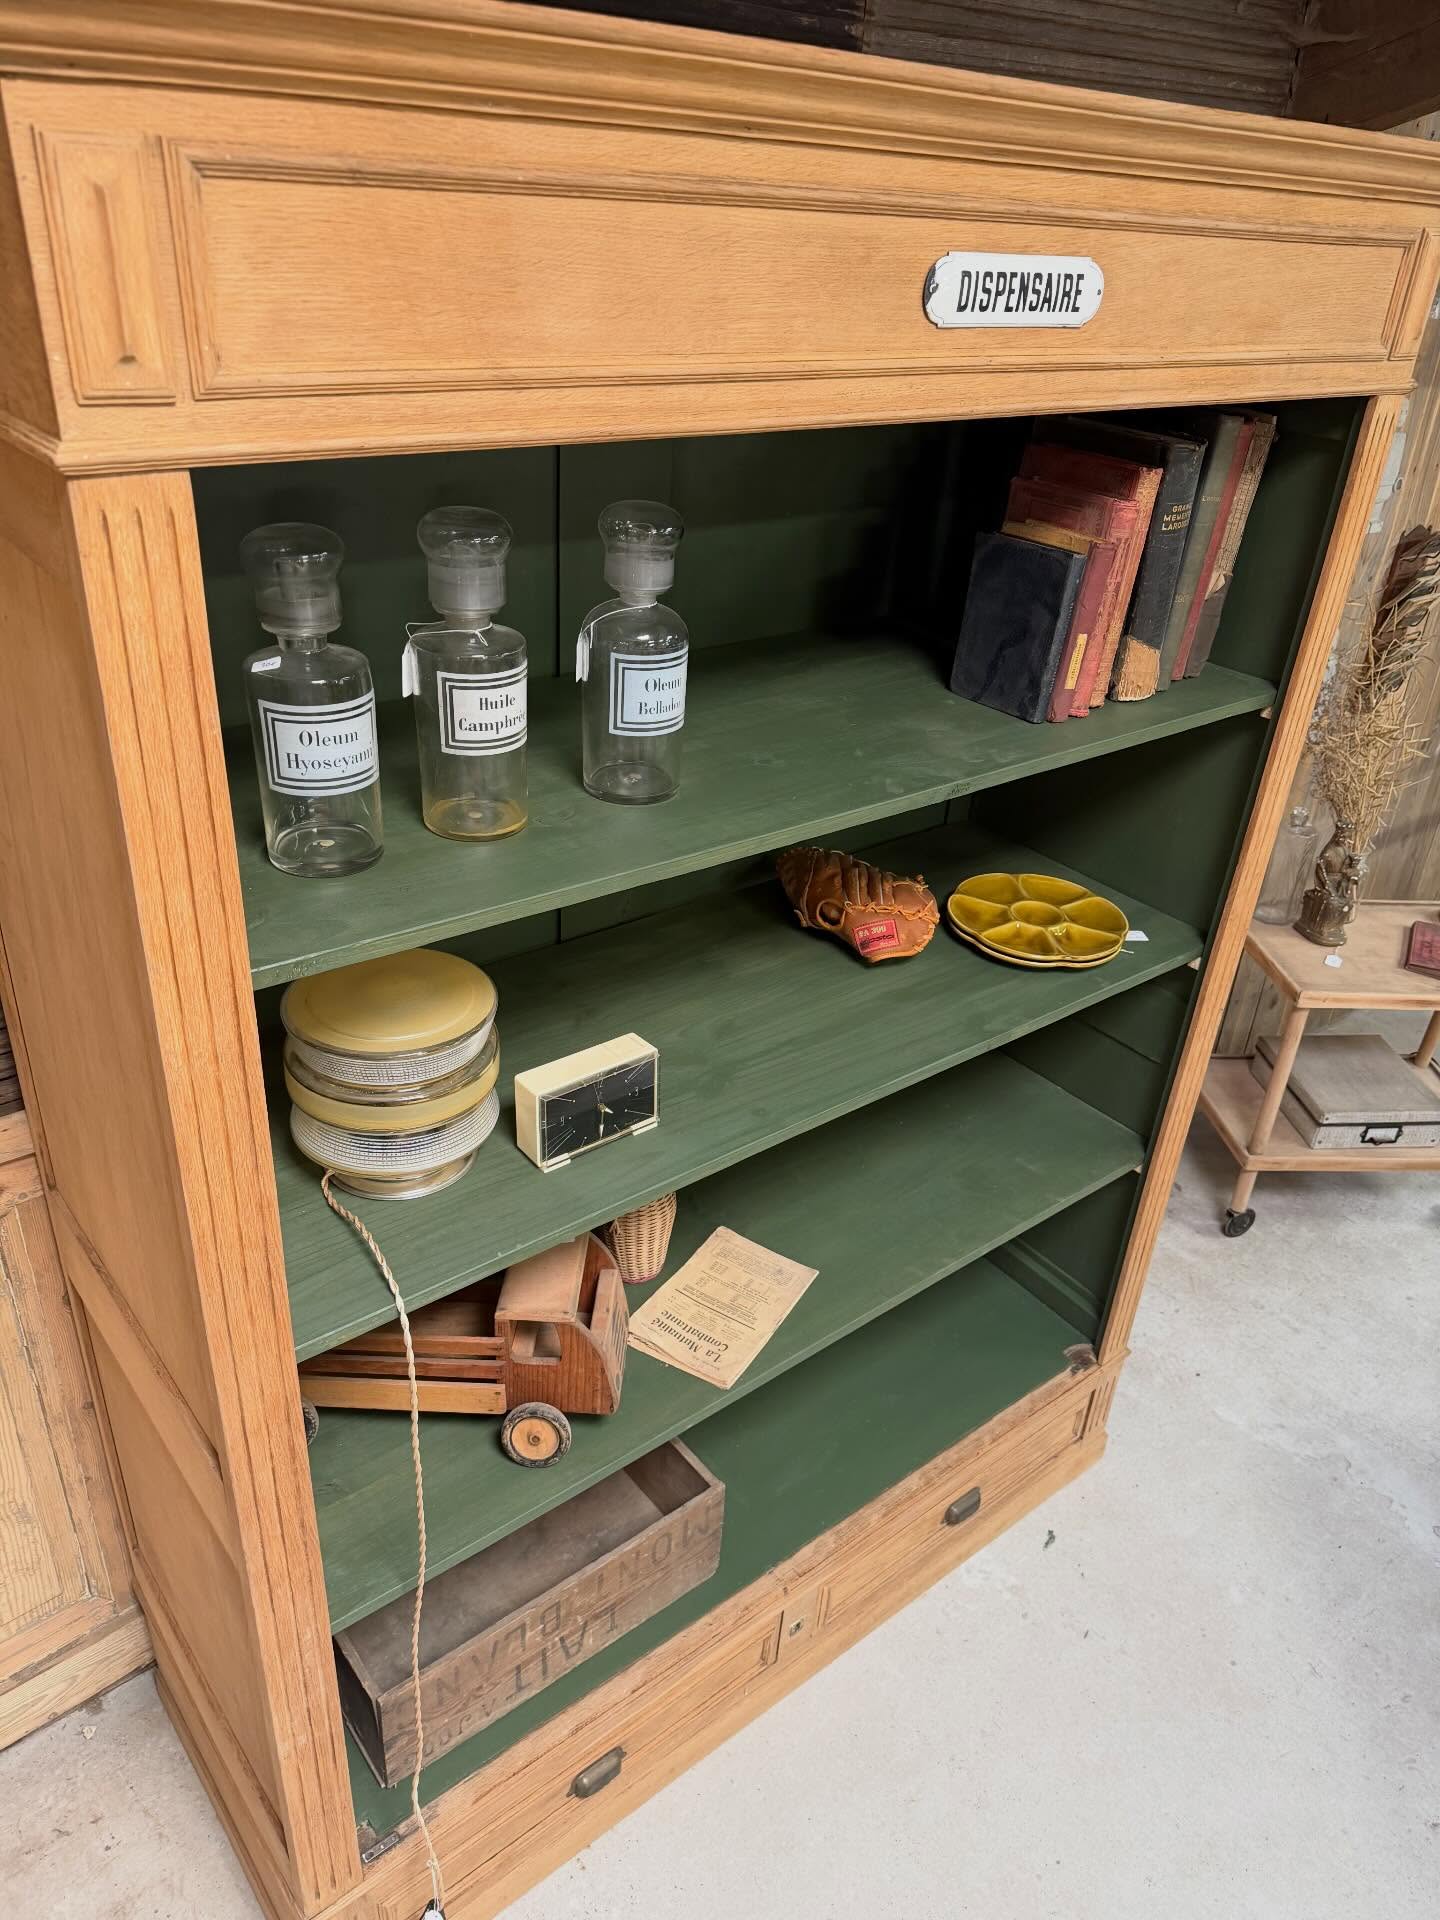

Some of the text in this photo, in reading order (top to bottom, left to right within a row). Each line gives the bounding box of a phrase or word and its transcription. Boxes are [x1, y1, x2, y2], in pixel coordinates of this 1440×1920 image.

[956, 270, 1085, 312] DISPENSAIRE
[479, 694, 516, 711] Huile
[298, 730, 359, 747] Oleum
[650, 1317, 704, 1353] Mutualité
[660, 1310, 729, 1352] Combattante
[704, 1349, 721, 1363] La
[505, 1604, 617, 1701] LAIT
